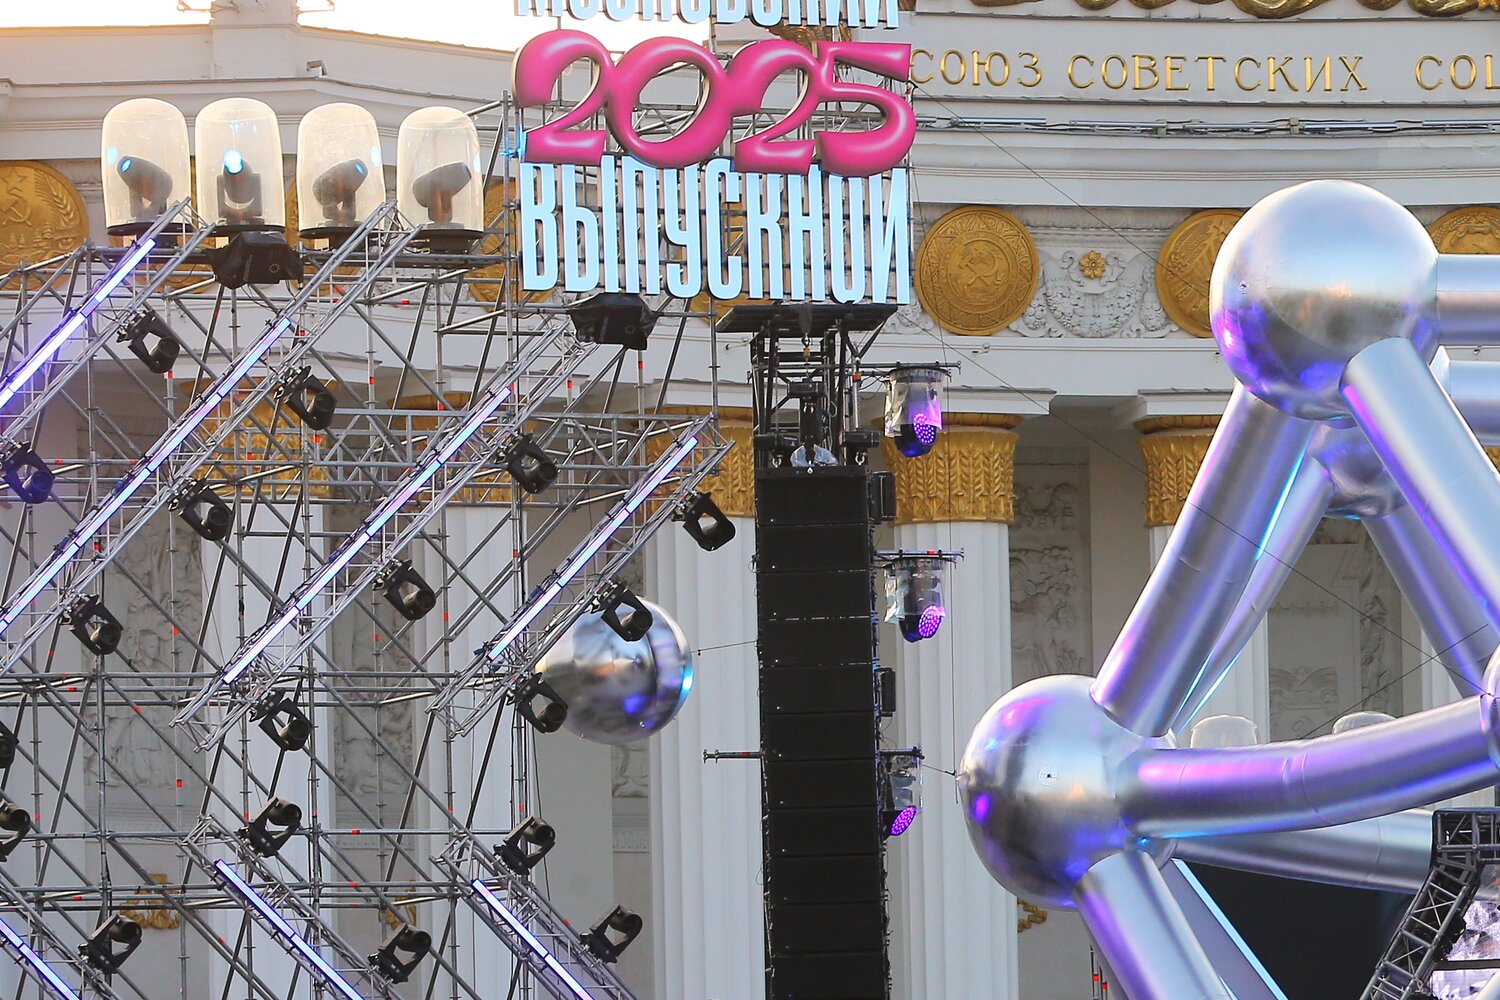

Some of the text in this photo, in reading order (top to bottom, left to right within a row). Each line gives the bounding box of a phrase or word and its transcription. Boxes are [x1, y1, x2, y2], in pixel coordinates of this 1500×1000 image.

[511, 28, 917, 177] 2025
[909, 49, 1043, 88] СОЮЗ
[1067, 54, 1368, 92] СОВЕТСКИХ
